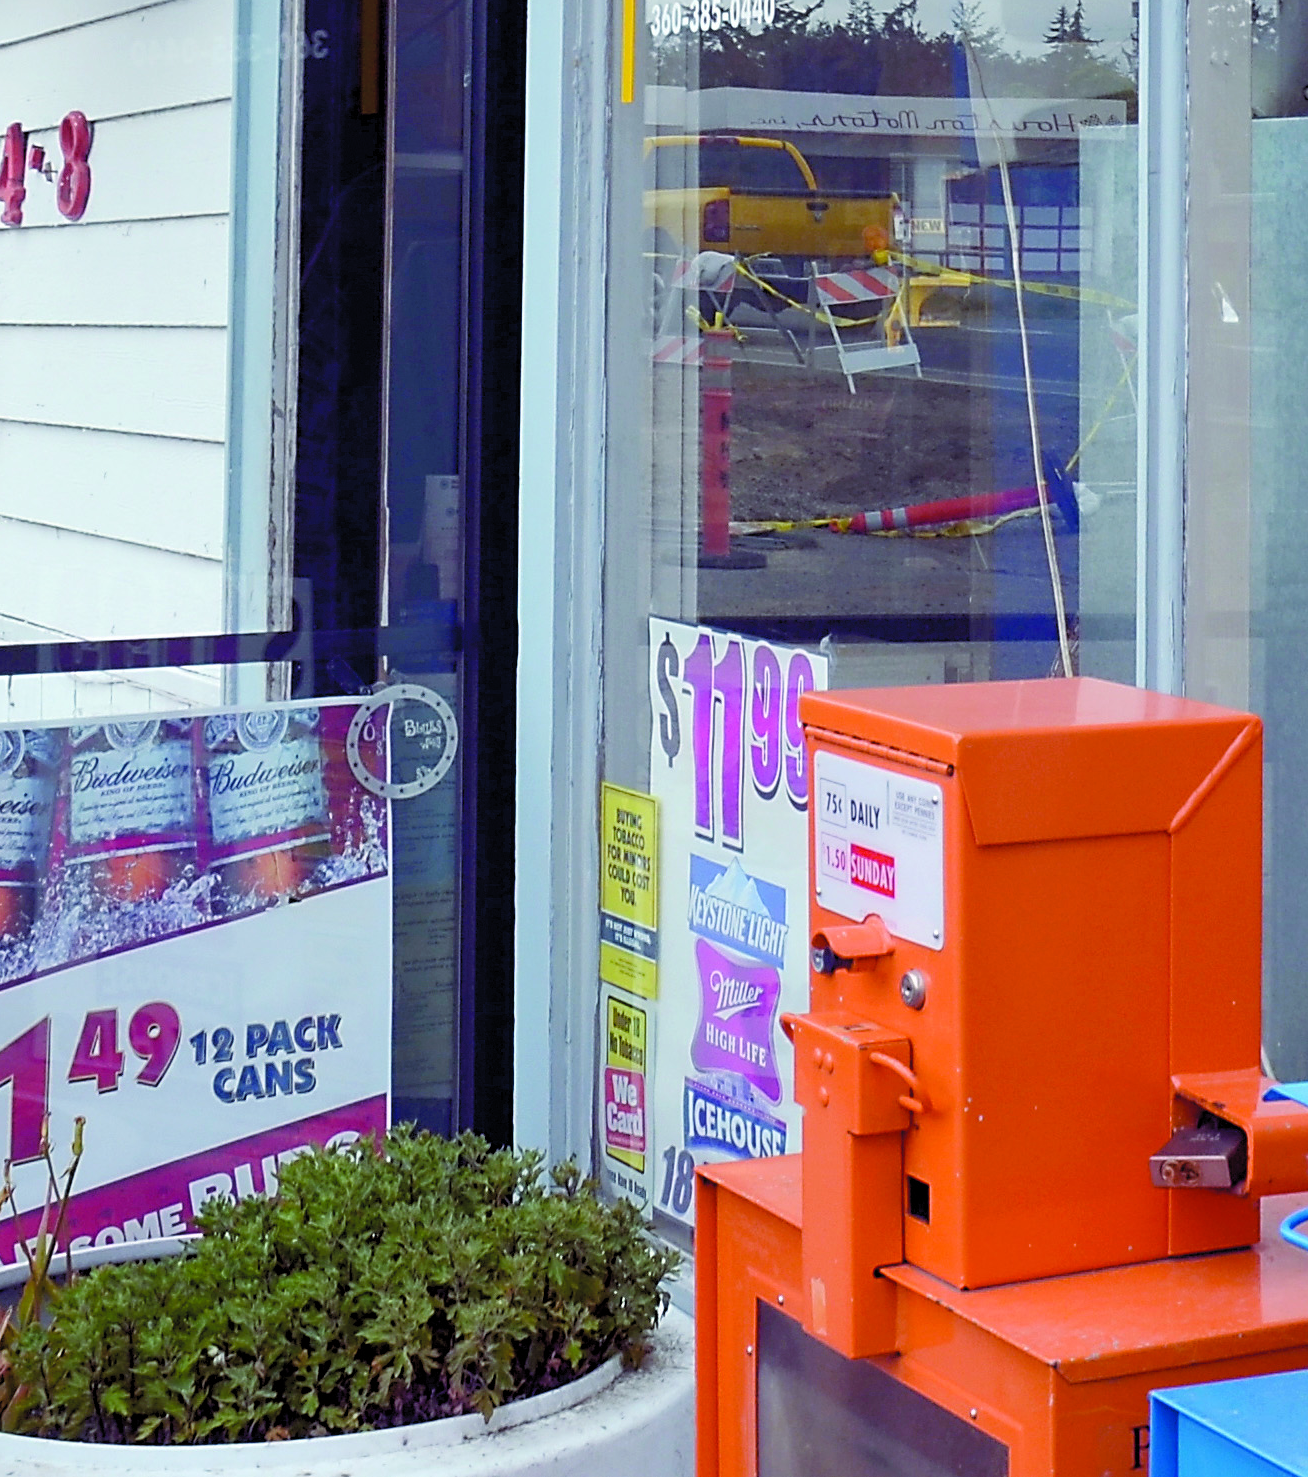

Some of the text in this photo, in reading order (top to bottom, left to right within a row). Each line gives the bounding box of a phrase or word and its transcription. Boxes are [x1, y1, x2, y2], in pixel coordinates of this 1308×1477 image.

[73, 755, 189, 794] Budweiser
[210, 755, 319, 797] Budweiser
[617, 808, 642, 830] BUYING
[850, 799, 880, 830] DAILY
[894, 802, 912, 815] EXCEPT
[613, 826, 645, 850] TOBACCO
[607, 844, 651, 873] FOR MINORS
[851, 854, 894, 892] SUNDAY
[608, 864, 650, 892] COULD COST
[621, 887, 637, 907] YOU.
[687, 884, 789, 958] KEYSTONE LIGHT
[710, 970, 764, 1010] Miller
[612, 1006, 632, 1033] Under
[190, 1014, 343, 1065] 12 PACK
[706, 1022, 767, 1068] HIGH LIFE
[213, 1057, 317, 1103] CANS
[612, 1073, 637, 1107] We
[606, 1101, 644, 1138] Card
[688, 1090, 782, 1158] ICEHOUSE
[68, 1202, 187, 1252] SOME
